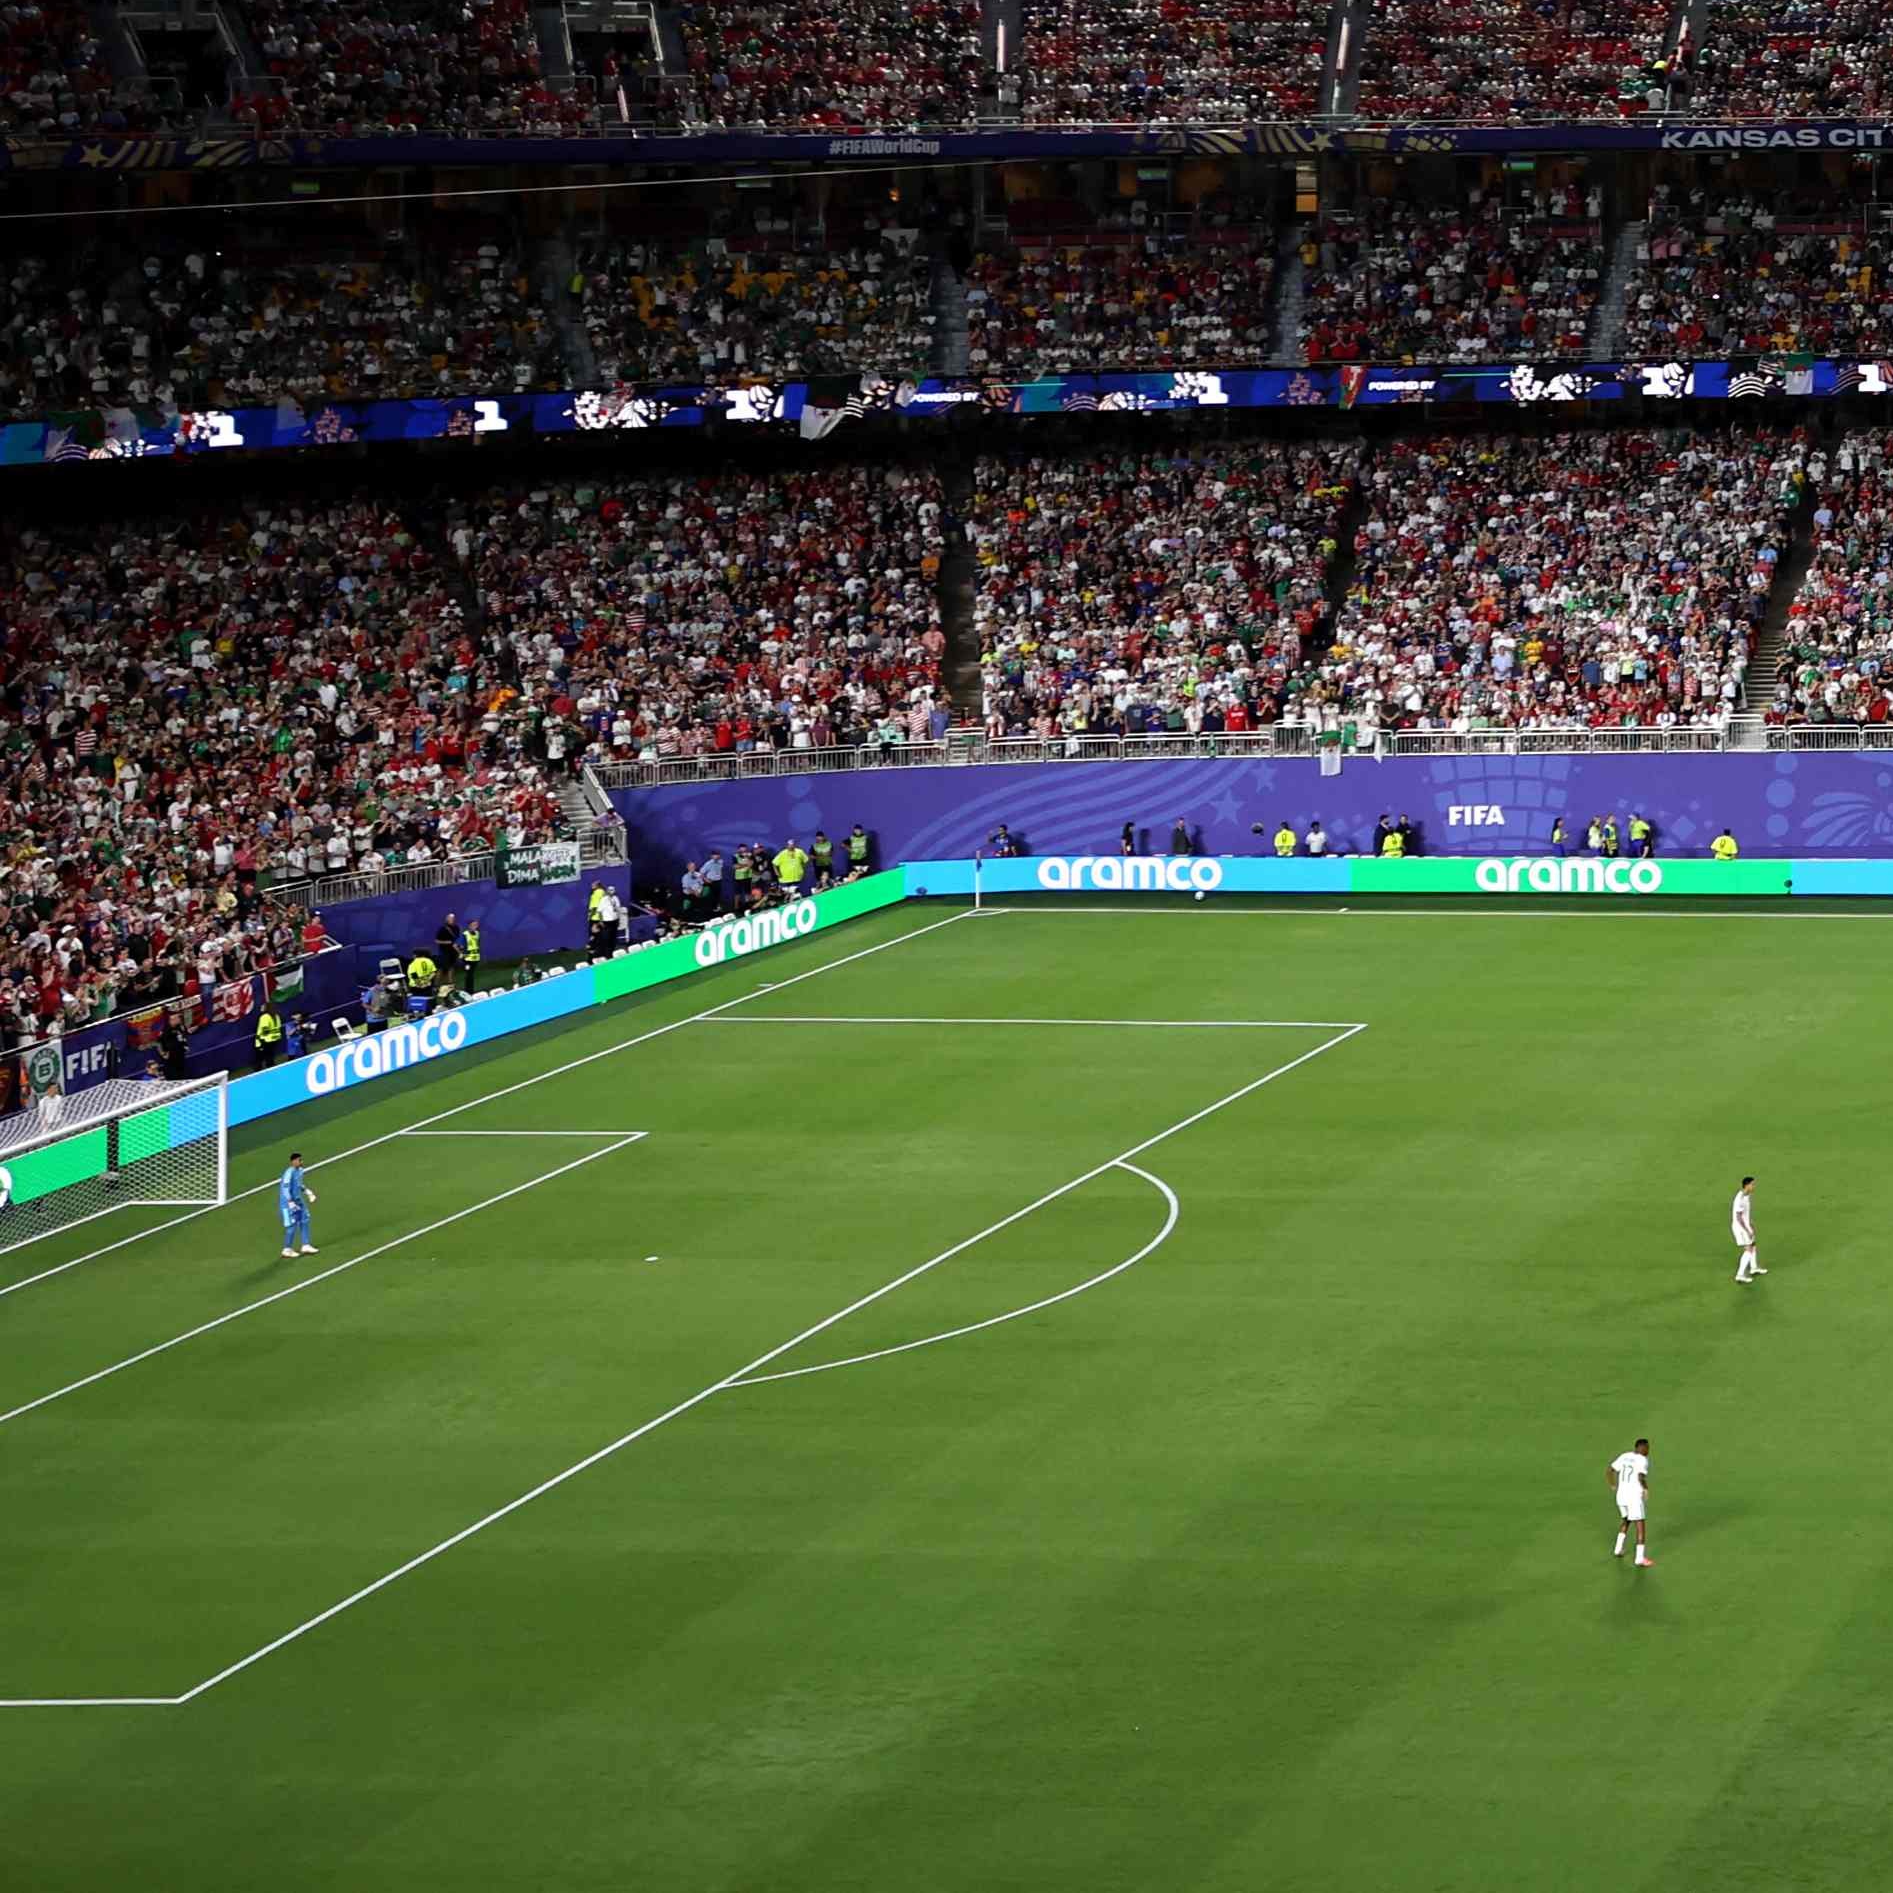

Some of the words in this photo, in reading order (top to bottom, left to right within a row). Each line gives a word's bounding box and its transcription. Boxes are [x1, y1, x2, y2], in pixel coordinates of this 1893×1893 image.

[829, 138, 940, 155] #FIFAWorldCup
[1662, 129, 1820, 148] KANSAS
[1420, 381, 1435, 390] BY
[963, 392, 979, 402] BY
[1448, 805, 1505, 826] FIFA
[1038, 857, 1221, 890] aramco
[1476, 859, 1662, 894] aramco
[695, 898, 816, 966] aramco
[306, 1010, 466, 1095] aramco
